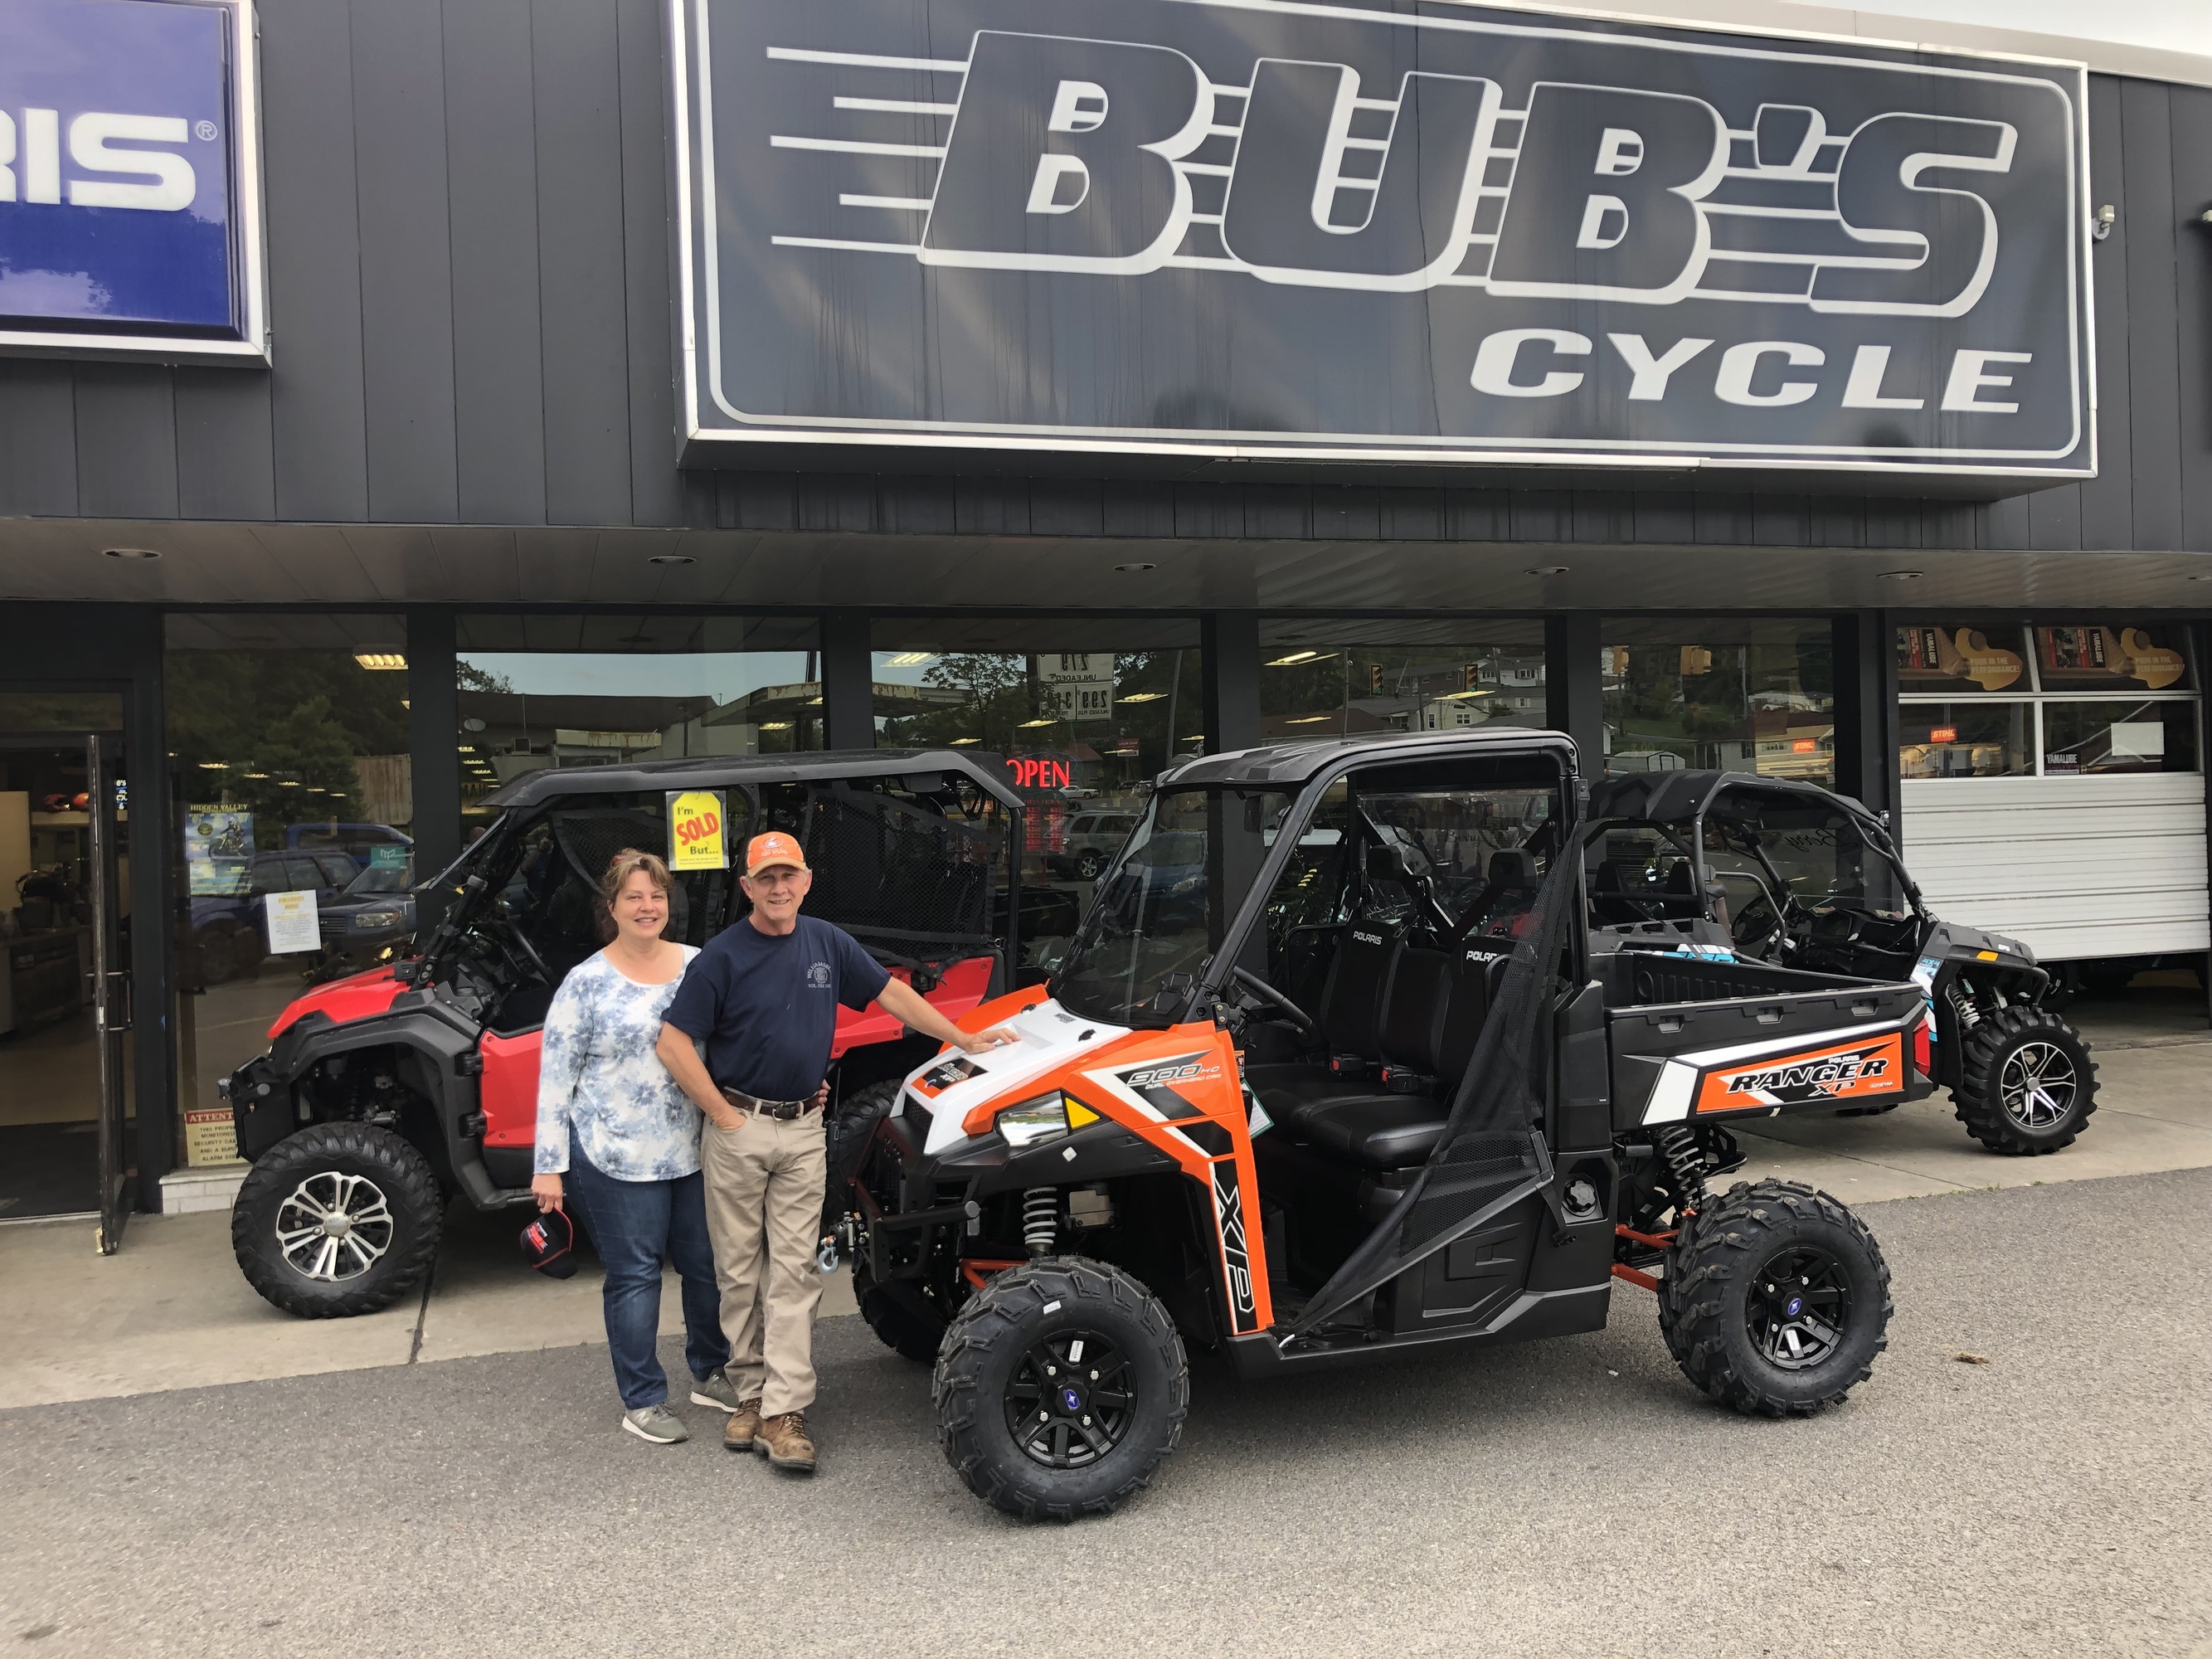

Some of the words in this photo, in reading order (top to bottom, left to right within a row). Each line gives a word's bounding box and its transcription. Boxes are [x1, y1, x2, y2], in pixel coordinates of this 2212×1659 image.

[0, 108, 197, 212] IS
[917, 28, 2019, 318] BUB'S
[1469, 327, 2034, 415] CYCLE
[1932, 728, 1956, 738] STIHL
[1795, 742, 1813, 750] STIHL
[2046, 753, 2078, 764] YAMALUBE
[676, 811, 719, 846] SOLD
[1353, 931, 1383, 946] POLARIS
[1828, 1054, 1860, 1064] POLARIS
[1125, 1063, 1203, 1087] 900
[1725, 1058, 1889, 1094] RANGER
[1145, 1082, 1165, 1090] DUAL
[1165, 1077, 1204, 1087] OVERHEAD
[1807, 1081, 1857, 1097] XP
[189, 1112, 234, 1122] ATTENT
[1210, 1170, 1256, 1313] XP
